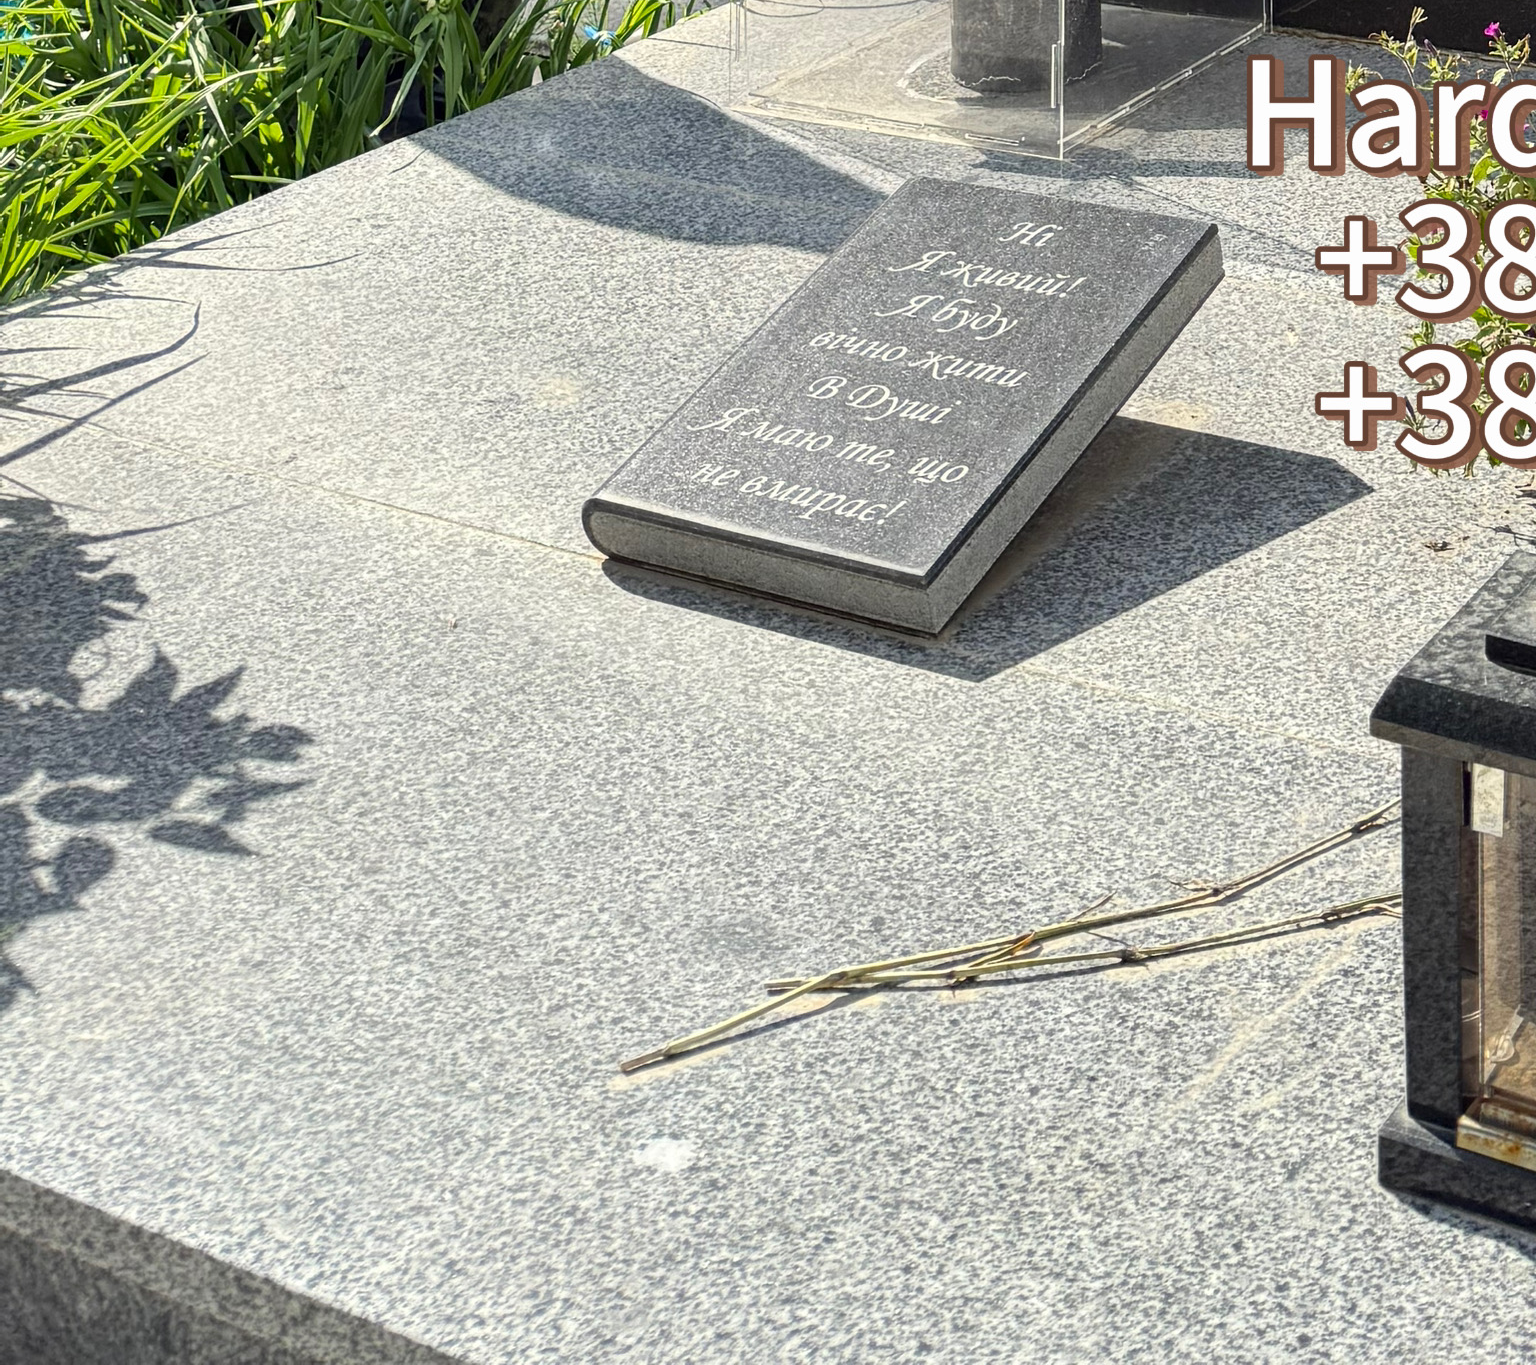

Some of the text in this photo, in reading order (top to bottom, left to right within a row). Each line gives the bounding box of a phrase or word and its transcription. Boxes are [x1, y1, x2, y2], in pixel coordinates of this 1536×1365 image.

[999, 221, 1062, 247] Ні
[889, 249, 1084, 299] Я живий!
[875, 293, 1018, 342] Я буду
[809, 327, 1028, 389] вічно жити
[806, 375, 961, 426] В Душі
[687, 406, 970, 486] Я маю те, що
[697, 458, 906, 527] не вмирає!
